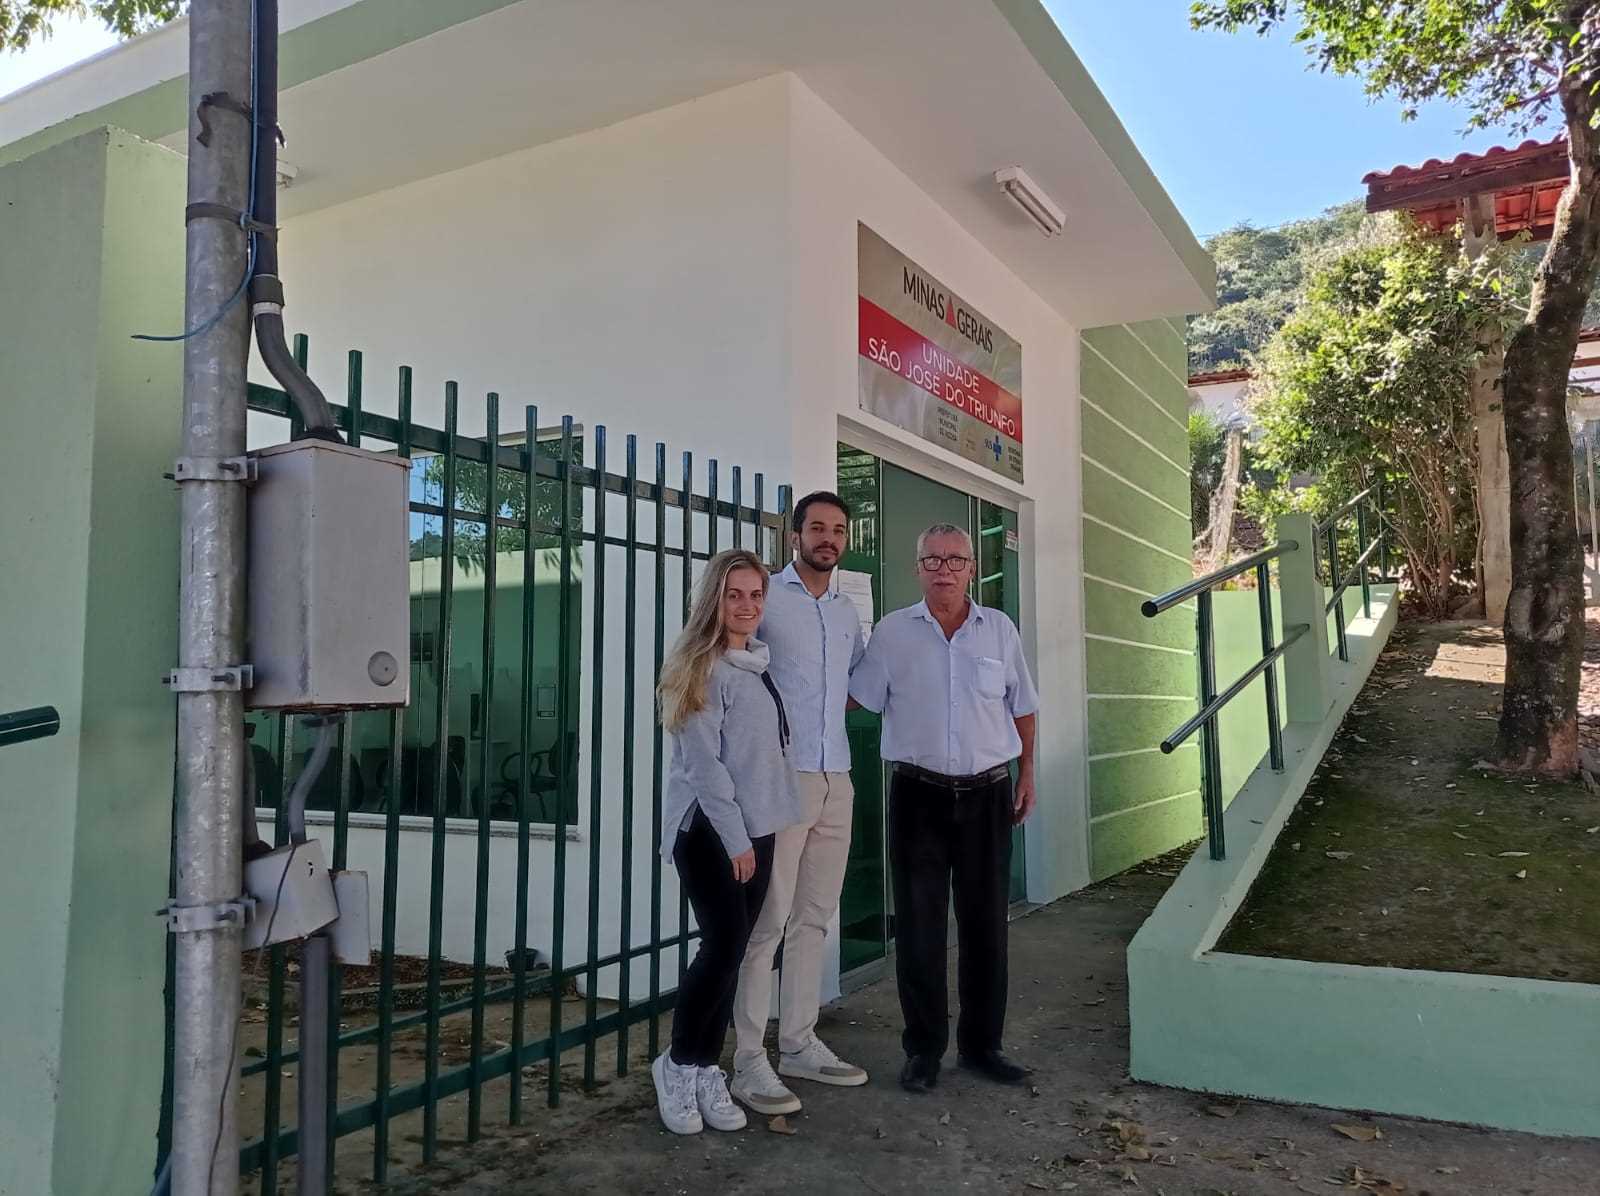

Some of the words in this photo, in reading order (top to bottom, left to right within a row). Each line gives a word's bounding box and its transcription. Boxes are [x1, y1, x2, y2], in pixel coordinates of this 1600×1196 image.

[903, 266, 945, 320] MINAS
[957, 308, 993, 354] GERAIS
[868, 337, 901, 372] SÃO
[905, 360, 941, 396] JOSÉ
[945, 382, 965, 408] DO
[967, 394, 1015, 436] TRIUNFO
[922, 343, 980, 394] UNIDADE
